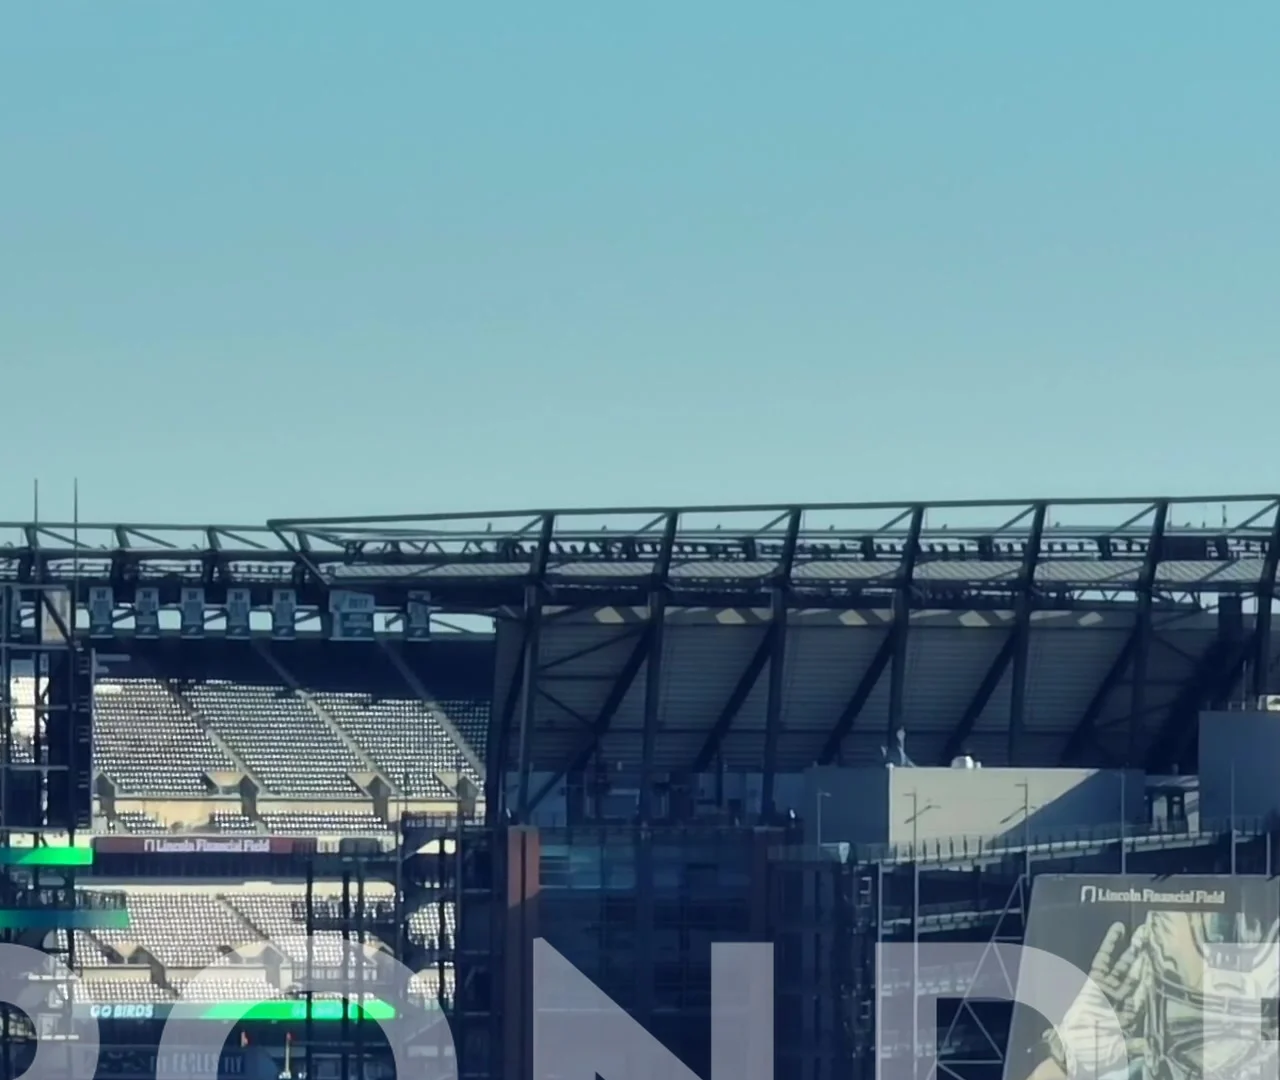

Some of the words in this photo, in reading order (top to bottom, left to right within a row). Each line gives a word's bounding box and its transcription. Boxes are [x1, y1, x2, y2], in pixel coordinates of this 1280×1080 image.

[1098, 888, 1141, 902] Lincoln
[1143, 889, 1194, 903] Financial
[1195, 890, 1225, 904] Field
[90, 1004, 111, 1018] GO
[114, 1004, 153, 1018] BIRDS
